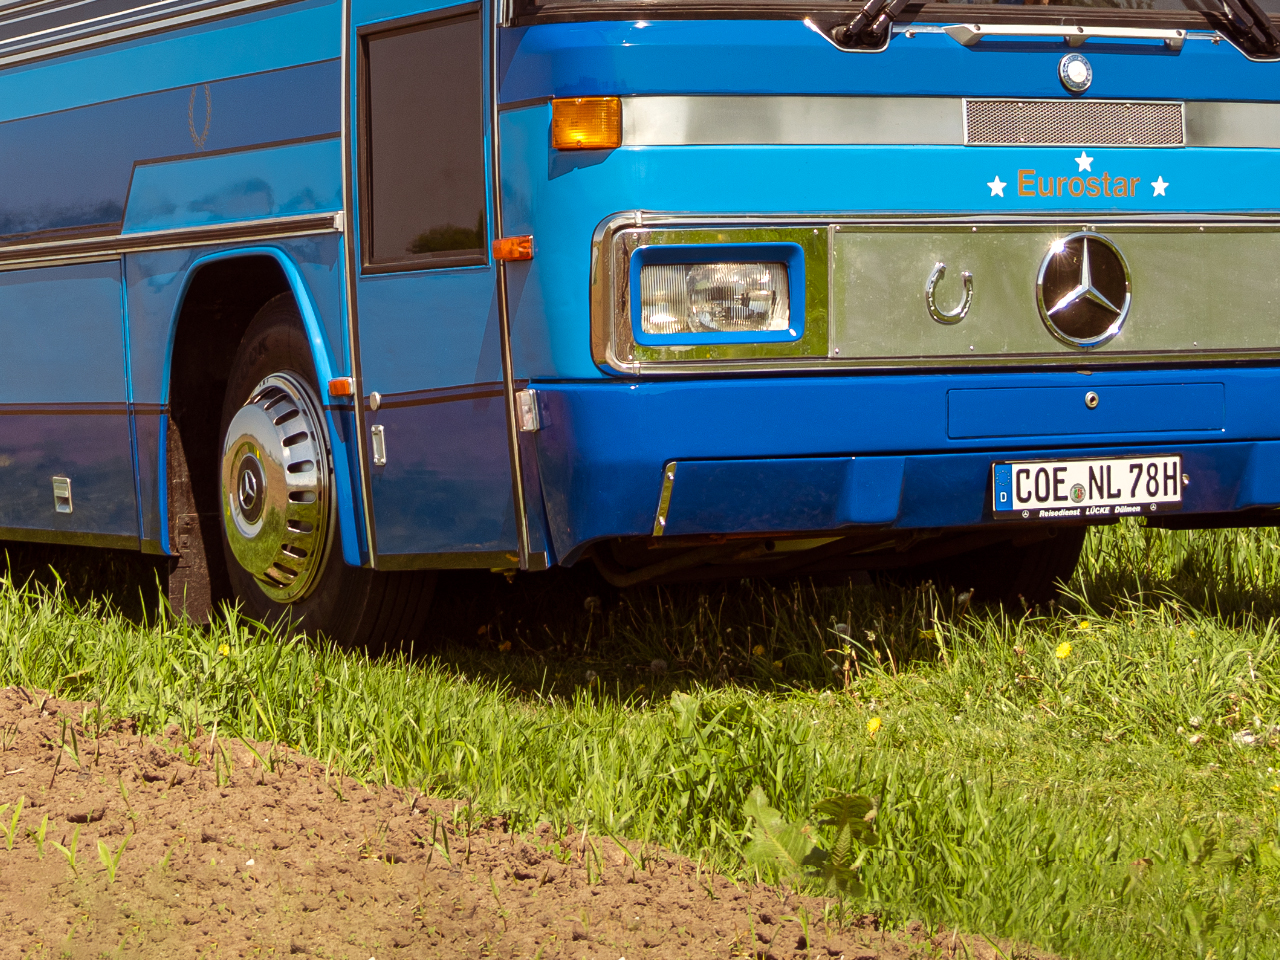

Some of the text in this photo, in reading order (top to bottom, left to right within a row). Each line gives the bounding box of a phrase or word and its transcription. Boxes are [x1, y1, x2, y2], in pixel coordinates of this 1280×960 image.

[1017, 168, 1141, 197] Eurostar
[1000, 491, 1007, 502] D
[1015, 461, 1178, 504] COE NL 78H
